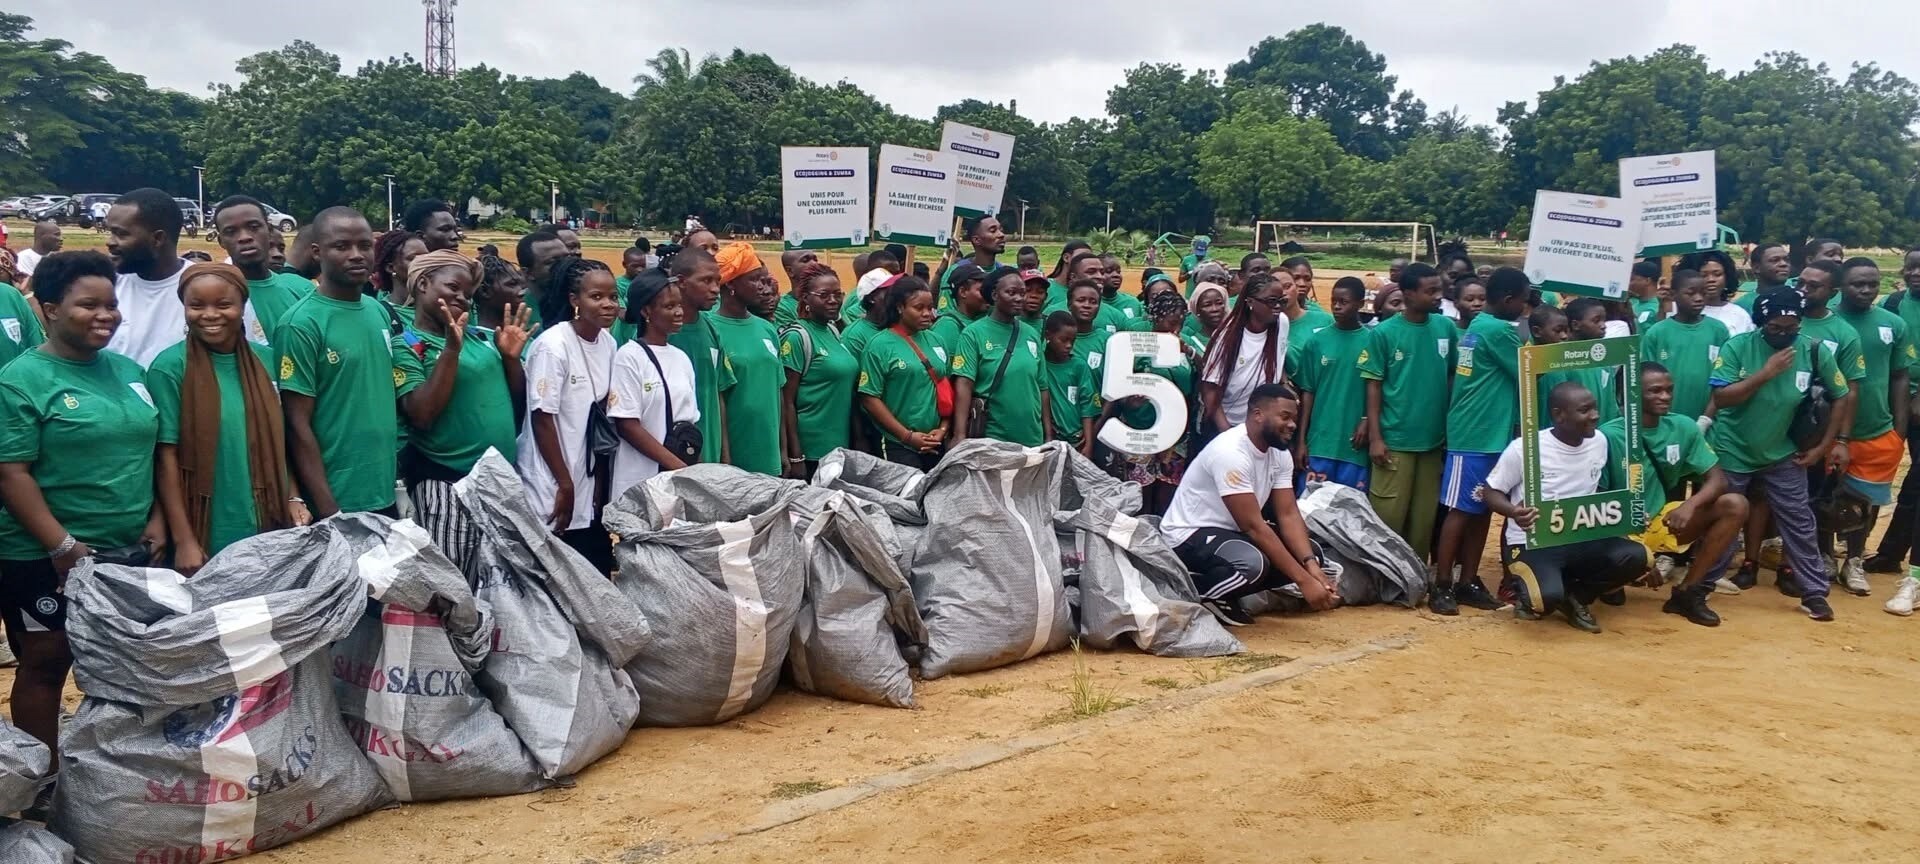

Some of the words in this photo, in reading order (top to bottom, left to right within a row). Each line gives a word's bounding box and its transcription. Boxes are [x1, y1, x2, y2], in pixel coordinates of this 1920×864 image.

[892, 166, 922, 175] ECOJOGGING
[958, 163, 969, 171] USE
[969, 165, 1001, 177] PRIORITAIRE
[965, 172, 985, 181] ROTARY
[897, 192, 916, 200] SANTÉ
[812, 198, 857, 206] COMMUNAUTÉ
[888, 199, 917, 209] PREMIÈRE
[1552, 247, 1581, 256] DÉCHET
[1564, 350, 1590, 360] Rotary
[1096, 330, 1188, 455] 5
[1550, 508, 1565, 534] 5
[1571, 500, 1623, 530] ANS
